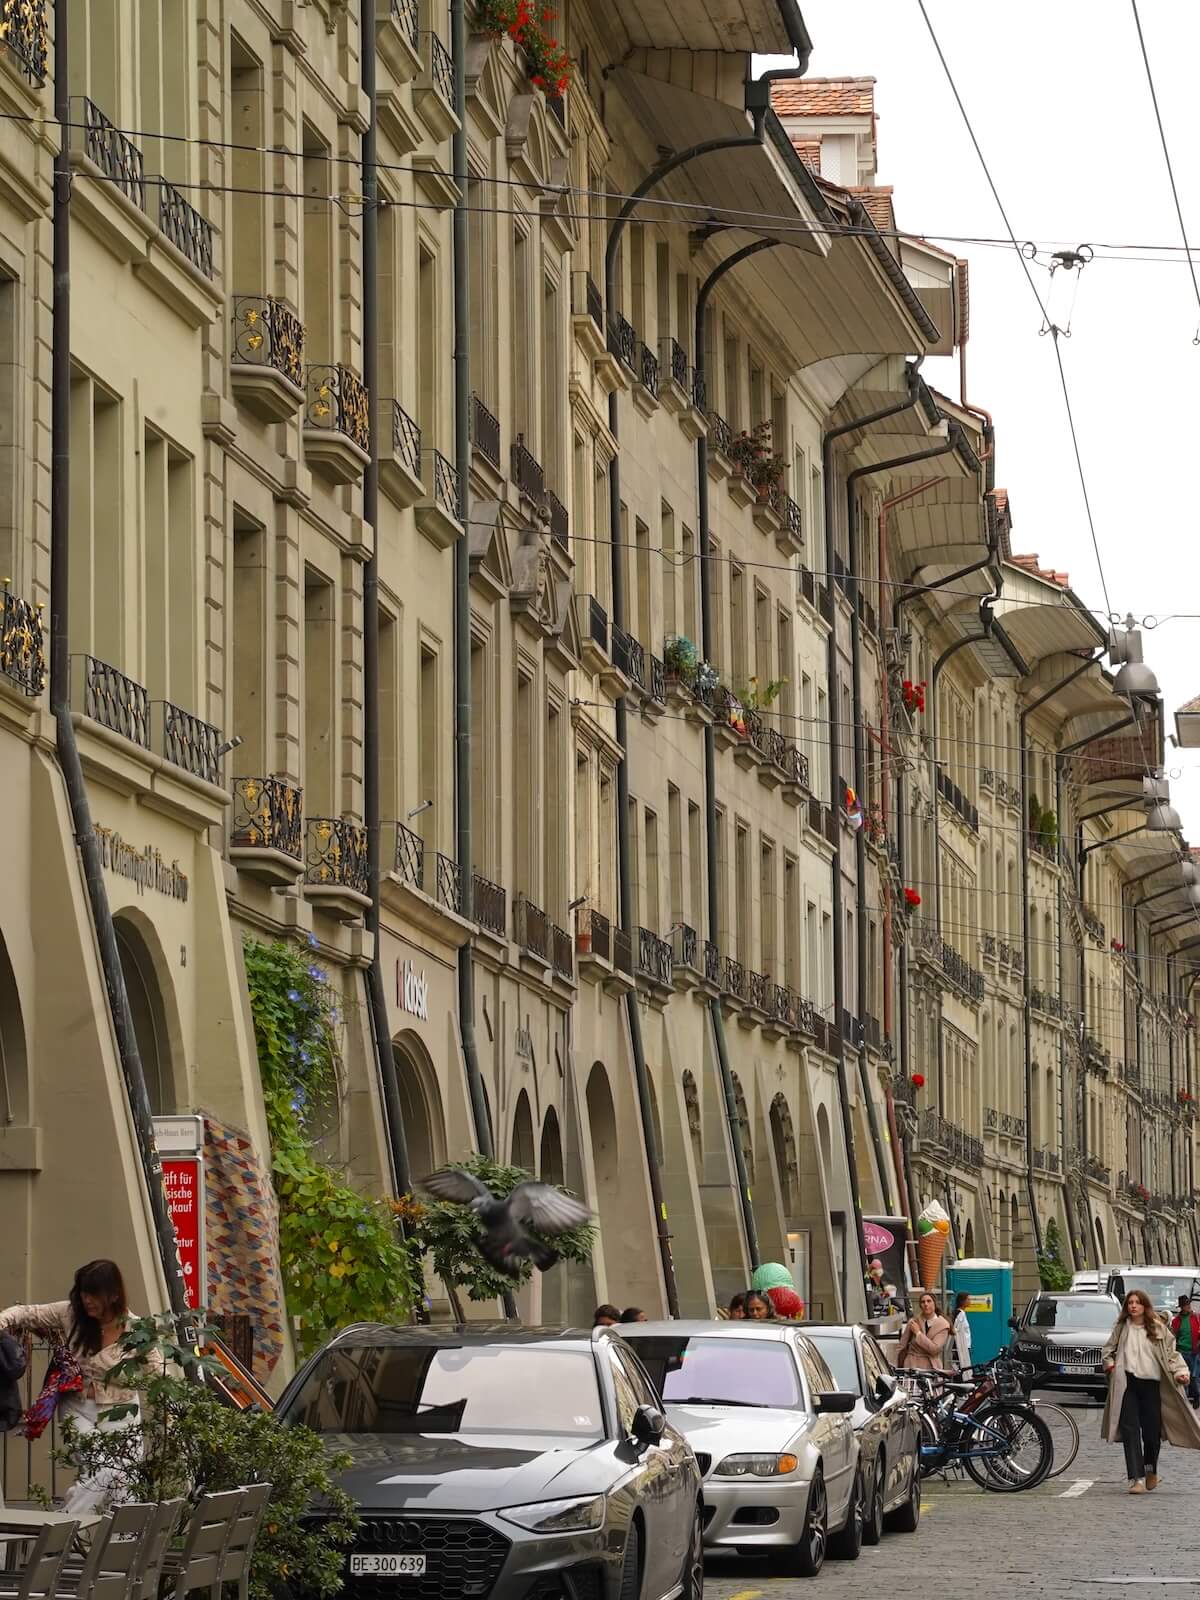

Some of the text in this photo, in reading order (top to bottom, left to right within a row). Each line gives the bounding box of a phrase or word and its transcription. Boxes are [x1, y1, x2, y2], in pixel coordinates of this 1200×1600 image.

[404, 958, 428, 1021] kiosk
[163, 1171, 192, 1185] äft für
[167, 1187, 192, 1198] sische
[177, 1238, 193, 1247] atur
